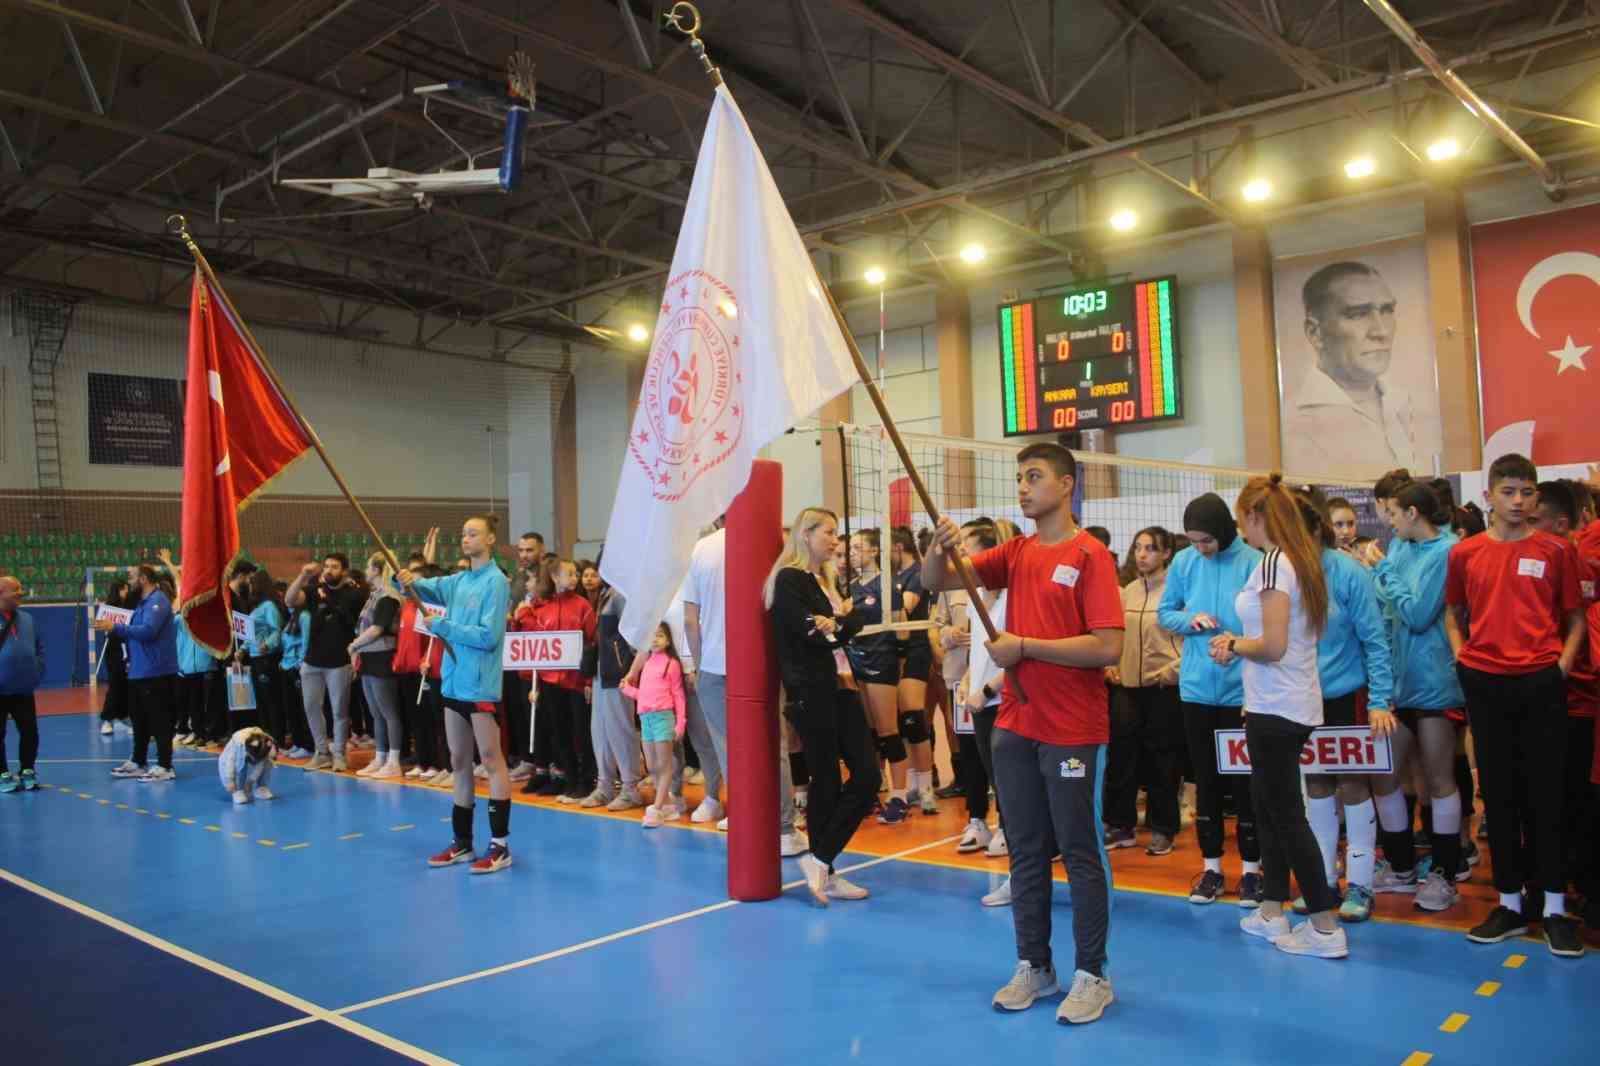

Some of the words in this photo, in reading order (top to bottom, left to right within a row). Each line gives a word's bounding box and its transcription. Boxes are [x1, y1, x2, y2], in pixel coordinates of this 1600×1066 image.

[1063, 290, 1107, 316] 10:03
[1057, 340, 1070, 361] 0
[1112, 331, 1124, 353] 0
[1054, 408, 1076, 428] 00
[1111, 400, 1135, 422] 00
[510, 635, 562, 662] SİVAS
